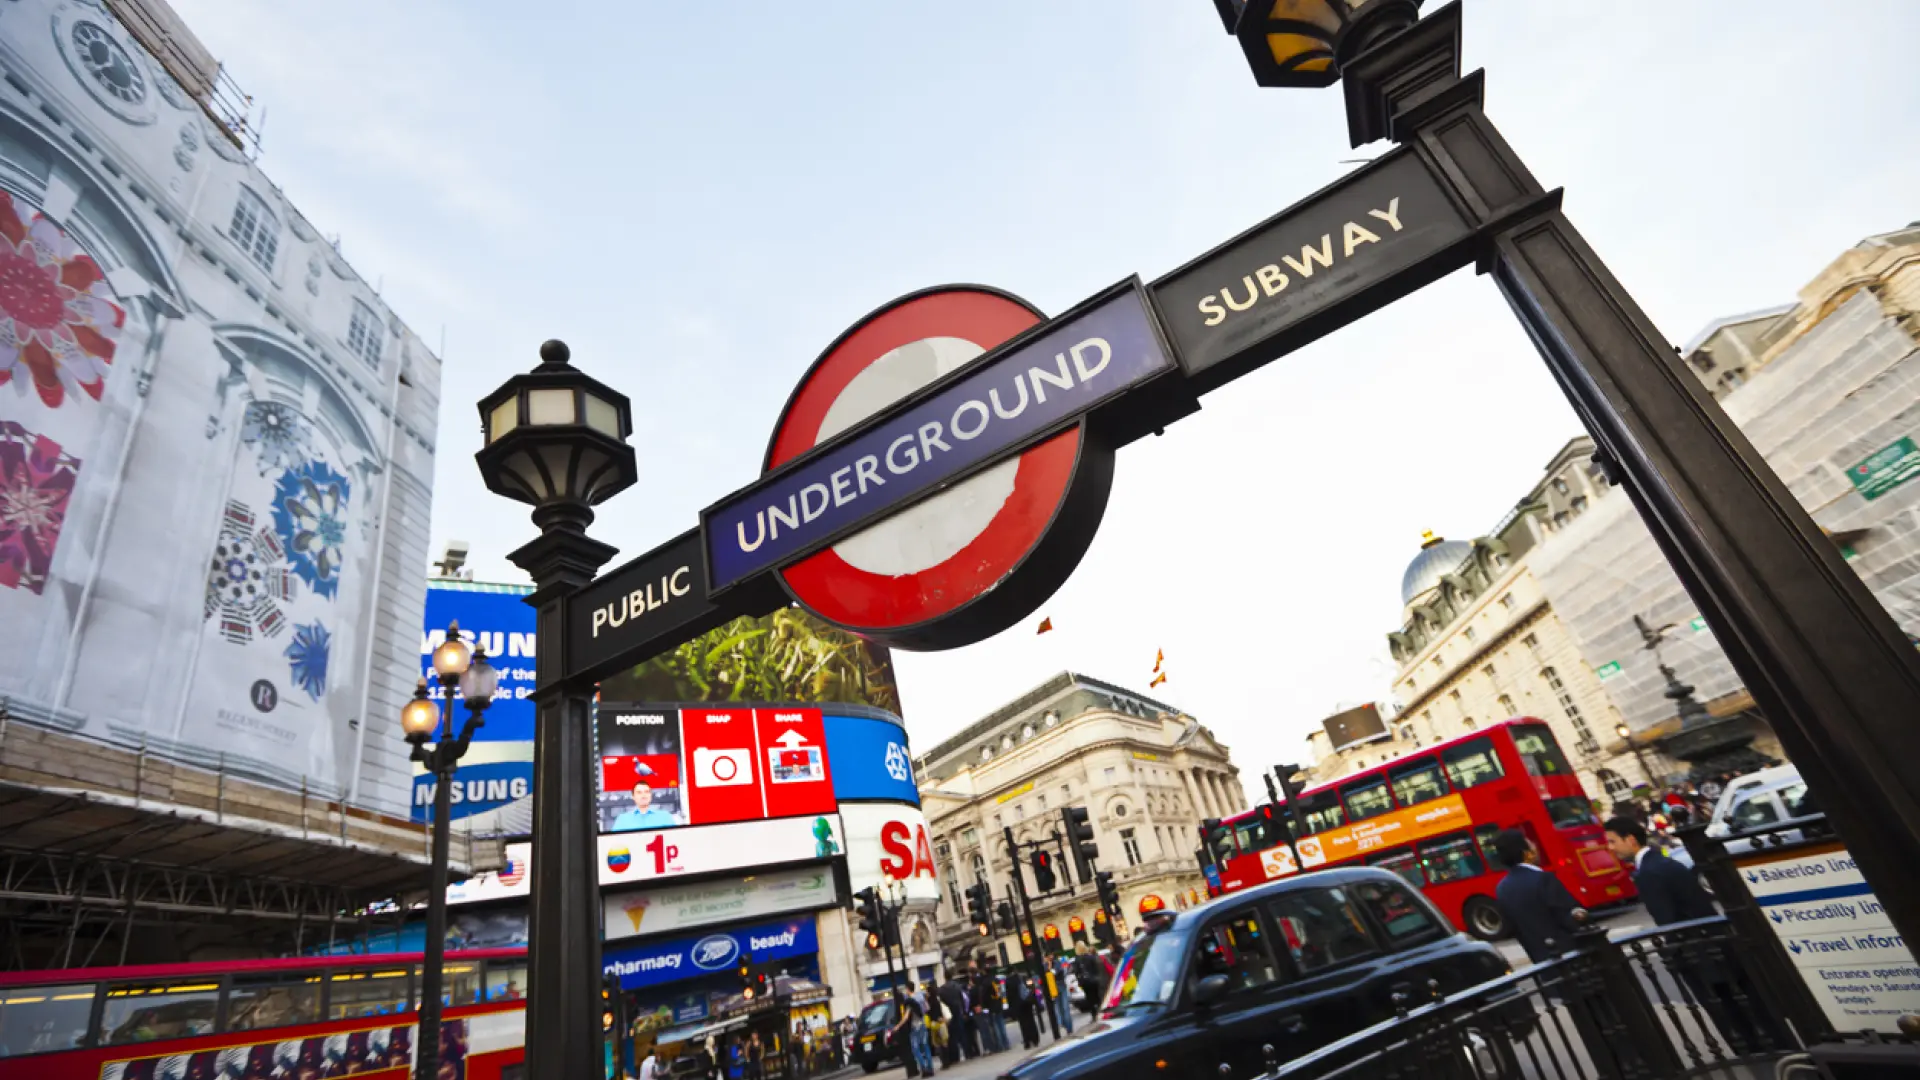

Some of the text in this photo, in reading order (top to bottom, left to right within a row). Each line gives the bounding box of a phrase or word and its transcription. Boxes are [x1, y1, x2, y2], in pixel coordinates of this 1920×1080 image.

[1199, 196, 1404, 328] SUBWAY
[736, 337, 1112, 554] UNDERGROUND
[592, 566, 692, 639] PUBLIC
[616, 714, 664, 725] POSITION
[706, 714, 731, 724] SNAP
[645, 834, 679, 874] 1p
[879, 820, 936, 880] SA
[1759, 864, 1826, 882] Bakerloo
[1783, 903, 1857, 922] Piccadilly
[604, 952, 682, 976] pharmacy
[751, 931, 795, 950] beauty
[1801, 937, 1852, 953] Travel
[1819, 969, 1871, 980] Entrance
